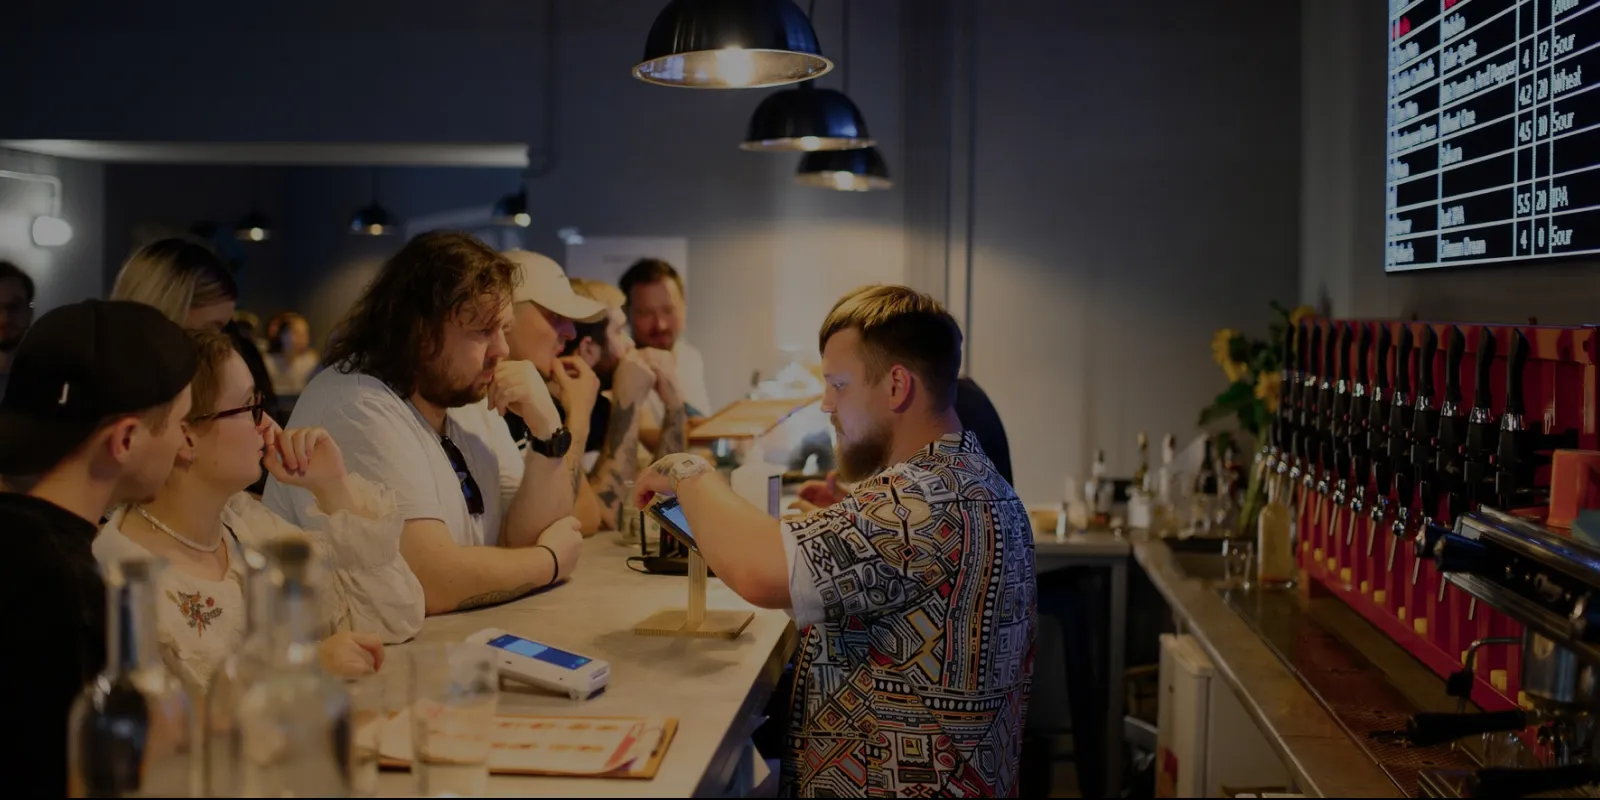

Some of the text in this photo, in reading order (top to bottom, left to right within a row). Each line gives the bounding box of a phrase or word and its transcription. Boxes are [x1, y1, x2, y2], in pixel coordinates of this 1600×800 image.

[1538, 40, 1549, 62] 12
[1552, 33, 1576, 56] Sour
[1522, 48, 1530, 69] 4
[1537, 77, 1549, 100] 20
[1552, 65, 1582, 94] Wheat
[1537, 115, 1548, 137] 10
[1552, 111, 1575, 133] Sour
[1536, 190, 1547, 211] 20
[1520, 229, 1528, 249] 4
[1537, 227, 1545, 248] 0
[1550, 225, 1573, 247] Sour
